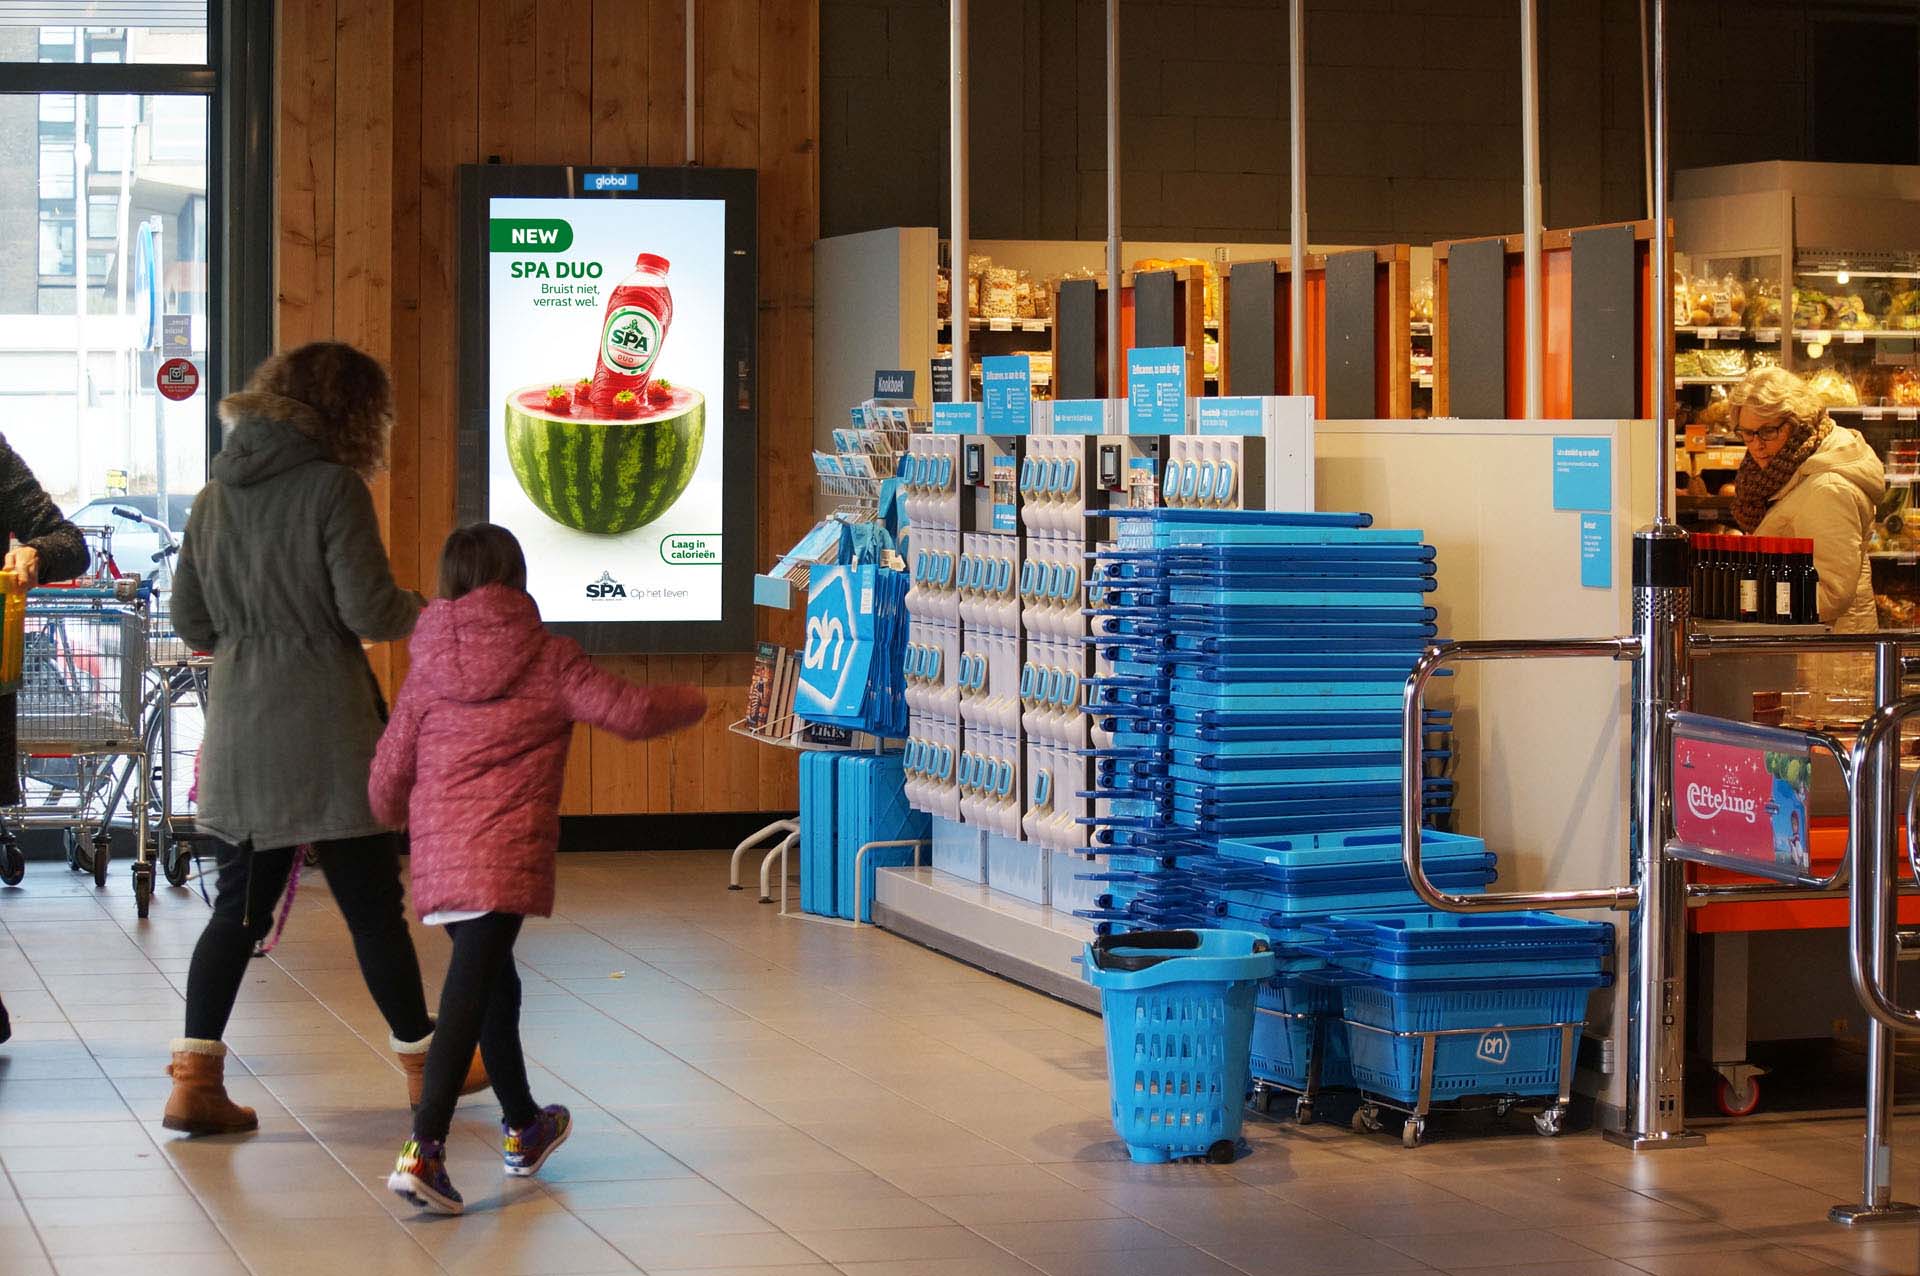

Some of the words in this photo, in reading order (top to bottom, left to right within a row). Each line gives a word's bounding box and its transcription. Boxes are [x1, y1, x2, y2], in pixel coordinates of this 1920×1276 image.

[596, 176, 627, 189] global
[511, 228, 558, 244] NEW
[510, 262, 550, 278] SPA
[556, 262, 603, 278] DUO
[541, 284, 574, 294] Bruist
[577, 284, 600, 295] niet,
[533, 297, 572, 306] verrast
[575, 296, 598, 306] wel.
[611, 330, 648, 352] SPA
[618, 354, 634, 362] DUO
[878, 376, 904, 392] Kookboek
[672, 540, 694, 550] Laag
[696, 540, 706, 548] in
[672, 550, 715, 558] calorieën
[586, 584, 626, 598] SPA
[630, 588, 644, 600] Op
[646, 589, 661, 598] het
[664, 589, 688, 598] leven
